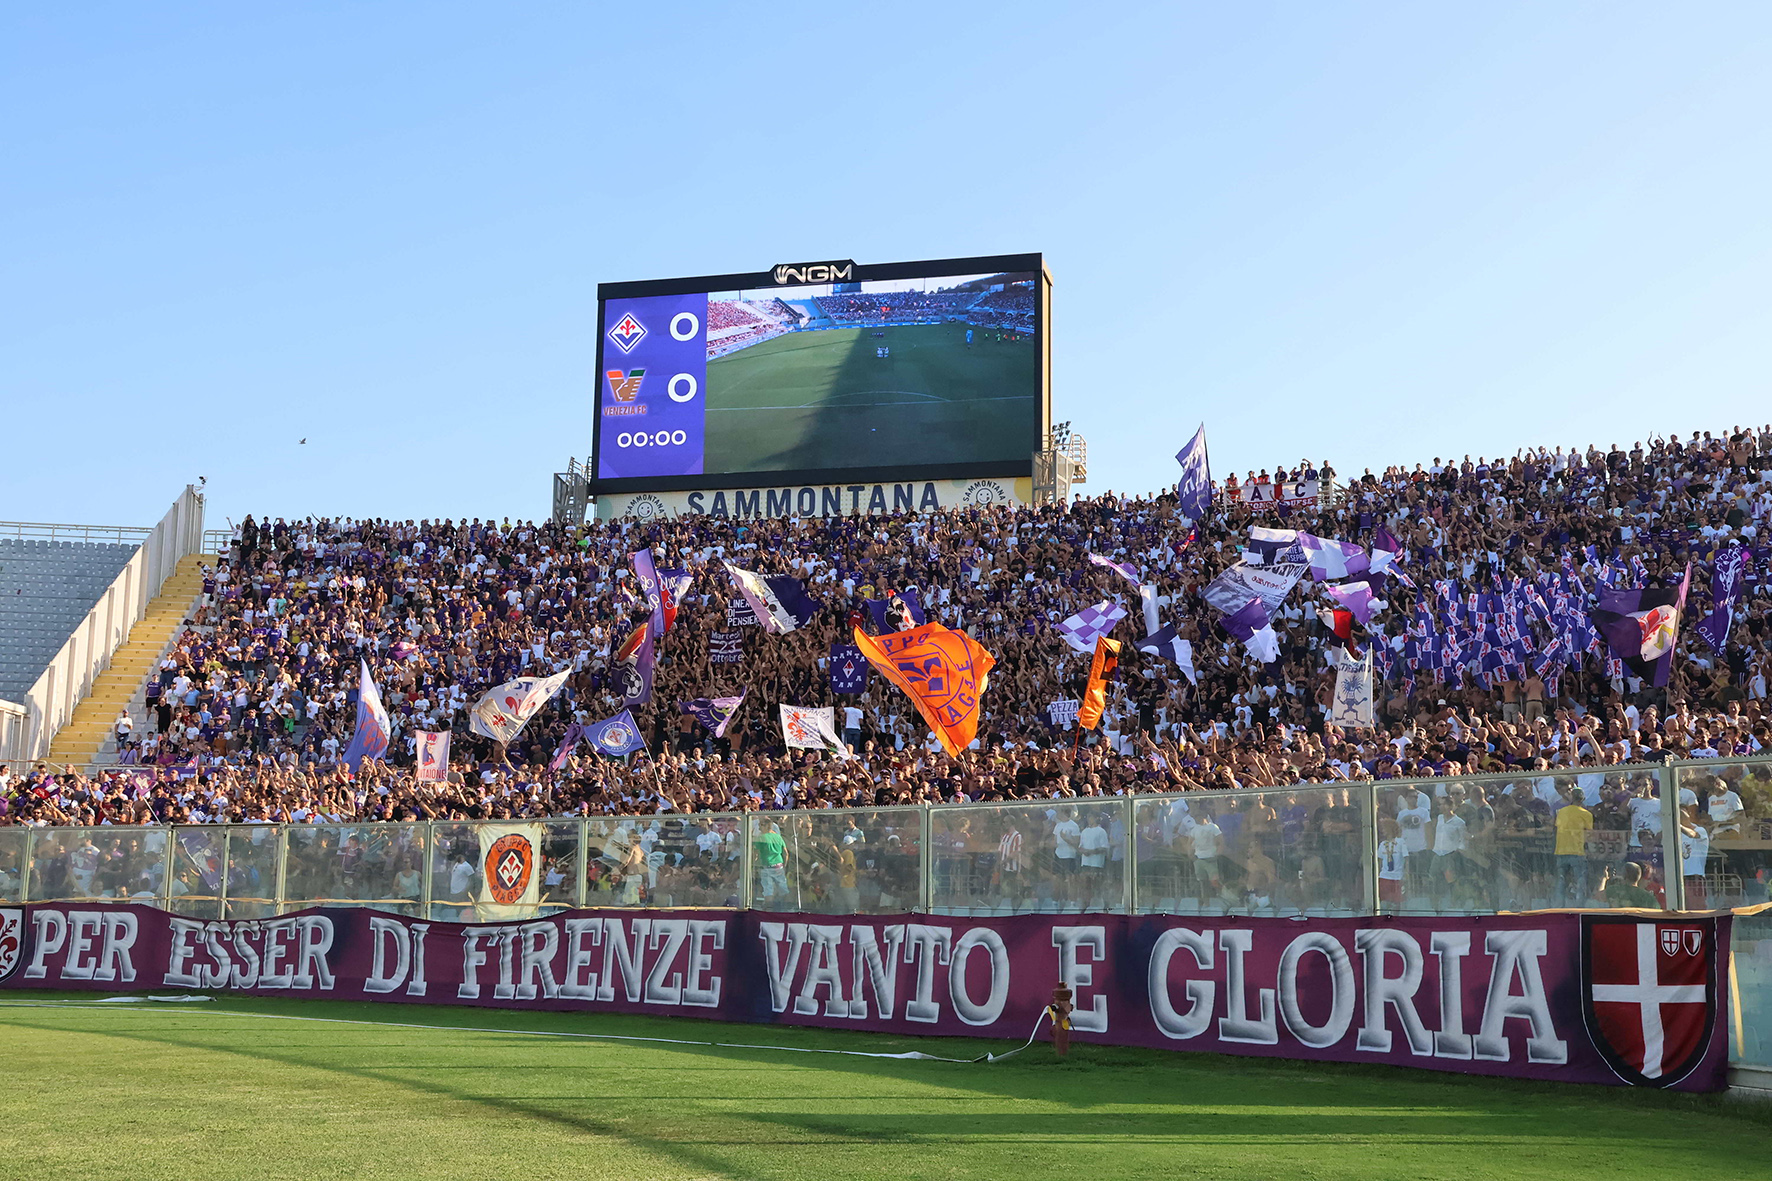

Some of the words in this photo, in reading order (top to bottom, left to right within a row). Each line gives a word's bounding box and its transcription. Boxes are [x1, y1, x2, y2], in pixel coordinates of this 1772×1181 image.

[669, 312, 699, 342] 0
[667, 372, 698, 403] 0
[603, 406, 636, 416] VENEZIA
[637, 405, 648, 415] FC
[617, 429, 687, 448] 00:00
[963, 479, 1007, 502] SAMMONTANA
[625, 494, 665, 515] SAMMONTANA
[687, 481, 940, 520] SAMMONTANA
[719, 640, 736, 654] 23
[832, 650, 866, 663] TANTA
[832, 675, 862, 688] LANA
[1051, 701, 1078, 713] PEZZA
[1054, 712, 1078, 723] VIVE
[496, 838, 529, 853] GRUPPO
[24, 909, 138, 982] PER
[162, 915, 336, 990] ESSER
[364, 916, 429, 996] DI
[457, 917, 727, 1008] FIRENZE
[759, 922, 1010, 1026] VANTO
[1052, 926, 1109, 1034] E
[1148, 927, 1568, 1064] GLORIA
